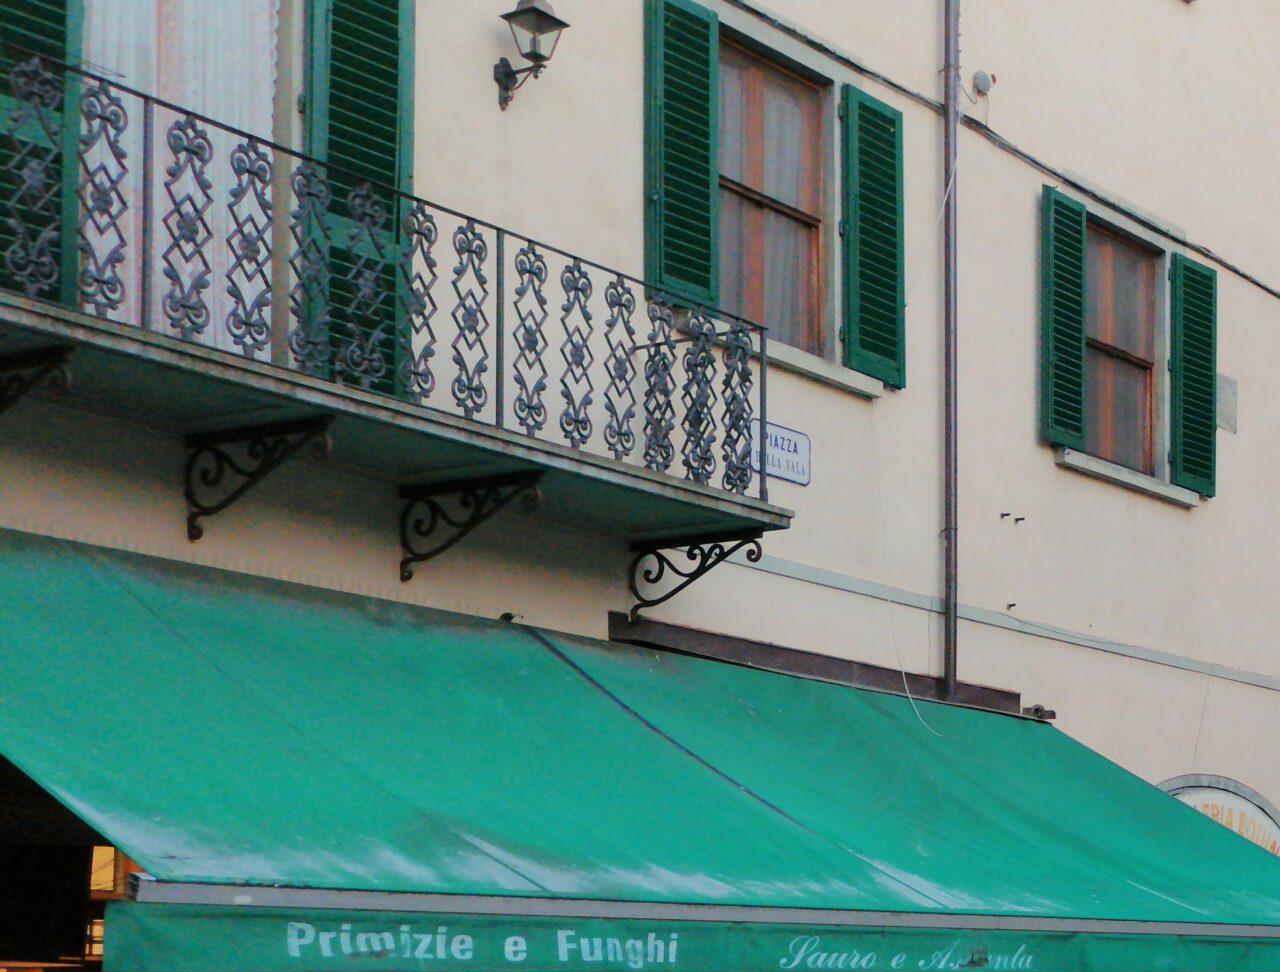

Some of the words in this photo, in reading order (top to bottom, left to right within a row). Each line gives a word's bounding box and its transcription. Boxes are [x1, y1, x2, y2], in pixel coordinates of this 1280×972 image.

[766, 432, 799, 455] IAZZA
[756, 450, 782, 469] DLLA
[286, 921, 474, 960] Primizie
[504, 935, 528, 962] e
[556, 929, 679, 970] Funghi
[779, 935, 877, 969] Sauro
[890, 951, 905, 969] e
